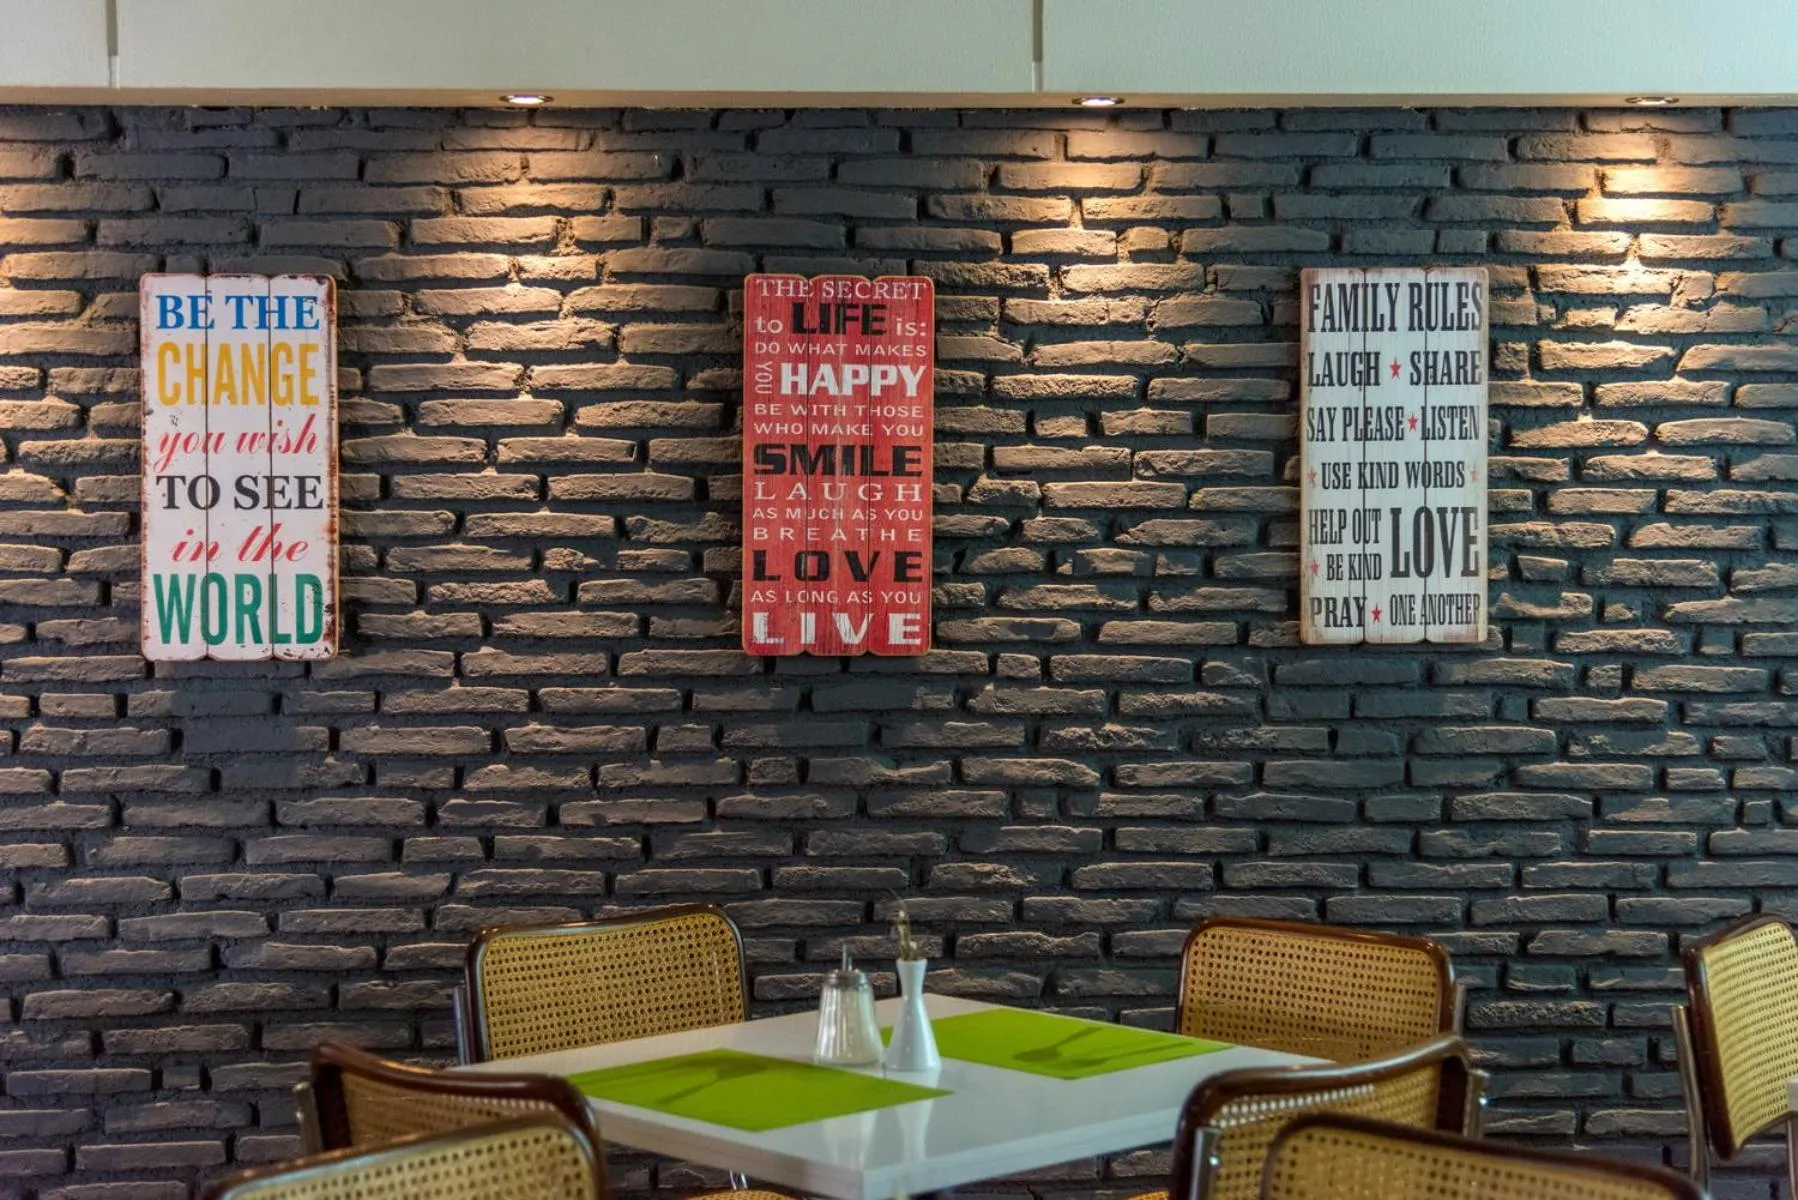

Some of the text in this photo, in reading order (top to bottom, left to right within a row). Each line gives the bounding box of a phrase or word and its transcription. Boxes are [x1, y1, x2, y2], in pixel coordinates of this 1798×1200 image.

[756, 279, 927, 300] THE SECRET
[156, 295, 320, 330] BE THE
[754, 303, 927, 336] to LIFE is:
[1308, 282, 1482, 332] FAMILY RULES
[755, 342, 927, 357] DO WHAT MAKES
[157, 342, 320, 406] CHANGE
[755, 361, 773, 394] YOU
[780, 363, 927, 397] HAPPY
[1308, 351, 1481, 386] LAUGH SHARE
[755, 404, 924, 417] BE WITH THOSE
[1307, 406, 1479, 442] SAY PLEASE LISTEN
[154, 413, 316, 473] you wish
[754, 423, 923, 436] WHO MAKE YOU
[754, 444, 922, 477] SMILE
[1322, 461, 1465, 489] USE KIND WORDS
[156, 475, 323, 510] TO SEE
[754, 482, 922, 501] LAUGH
[753, 508, 922, 520] AS MUCH AS YOU
[1308, 508, 1381, 544] HELP OUT
[171, 523, 309, 561] in the
[754, 528, 921, 542] BREATHE
[1390, 506, 1479, 578] LOVE
[753, 550, 922, 582] LOVE
[1327, 553, 1381, 580] BE KIND
[153, 573, 323, 645] WORLD
[751, 591, 921, 603] AS LONG AS YOU
[1309, 594, 1480, 627] PRAY ONE ANOTHER
[753, 612, 921, 645] LIVE
